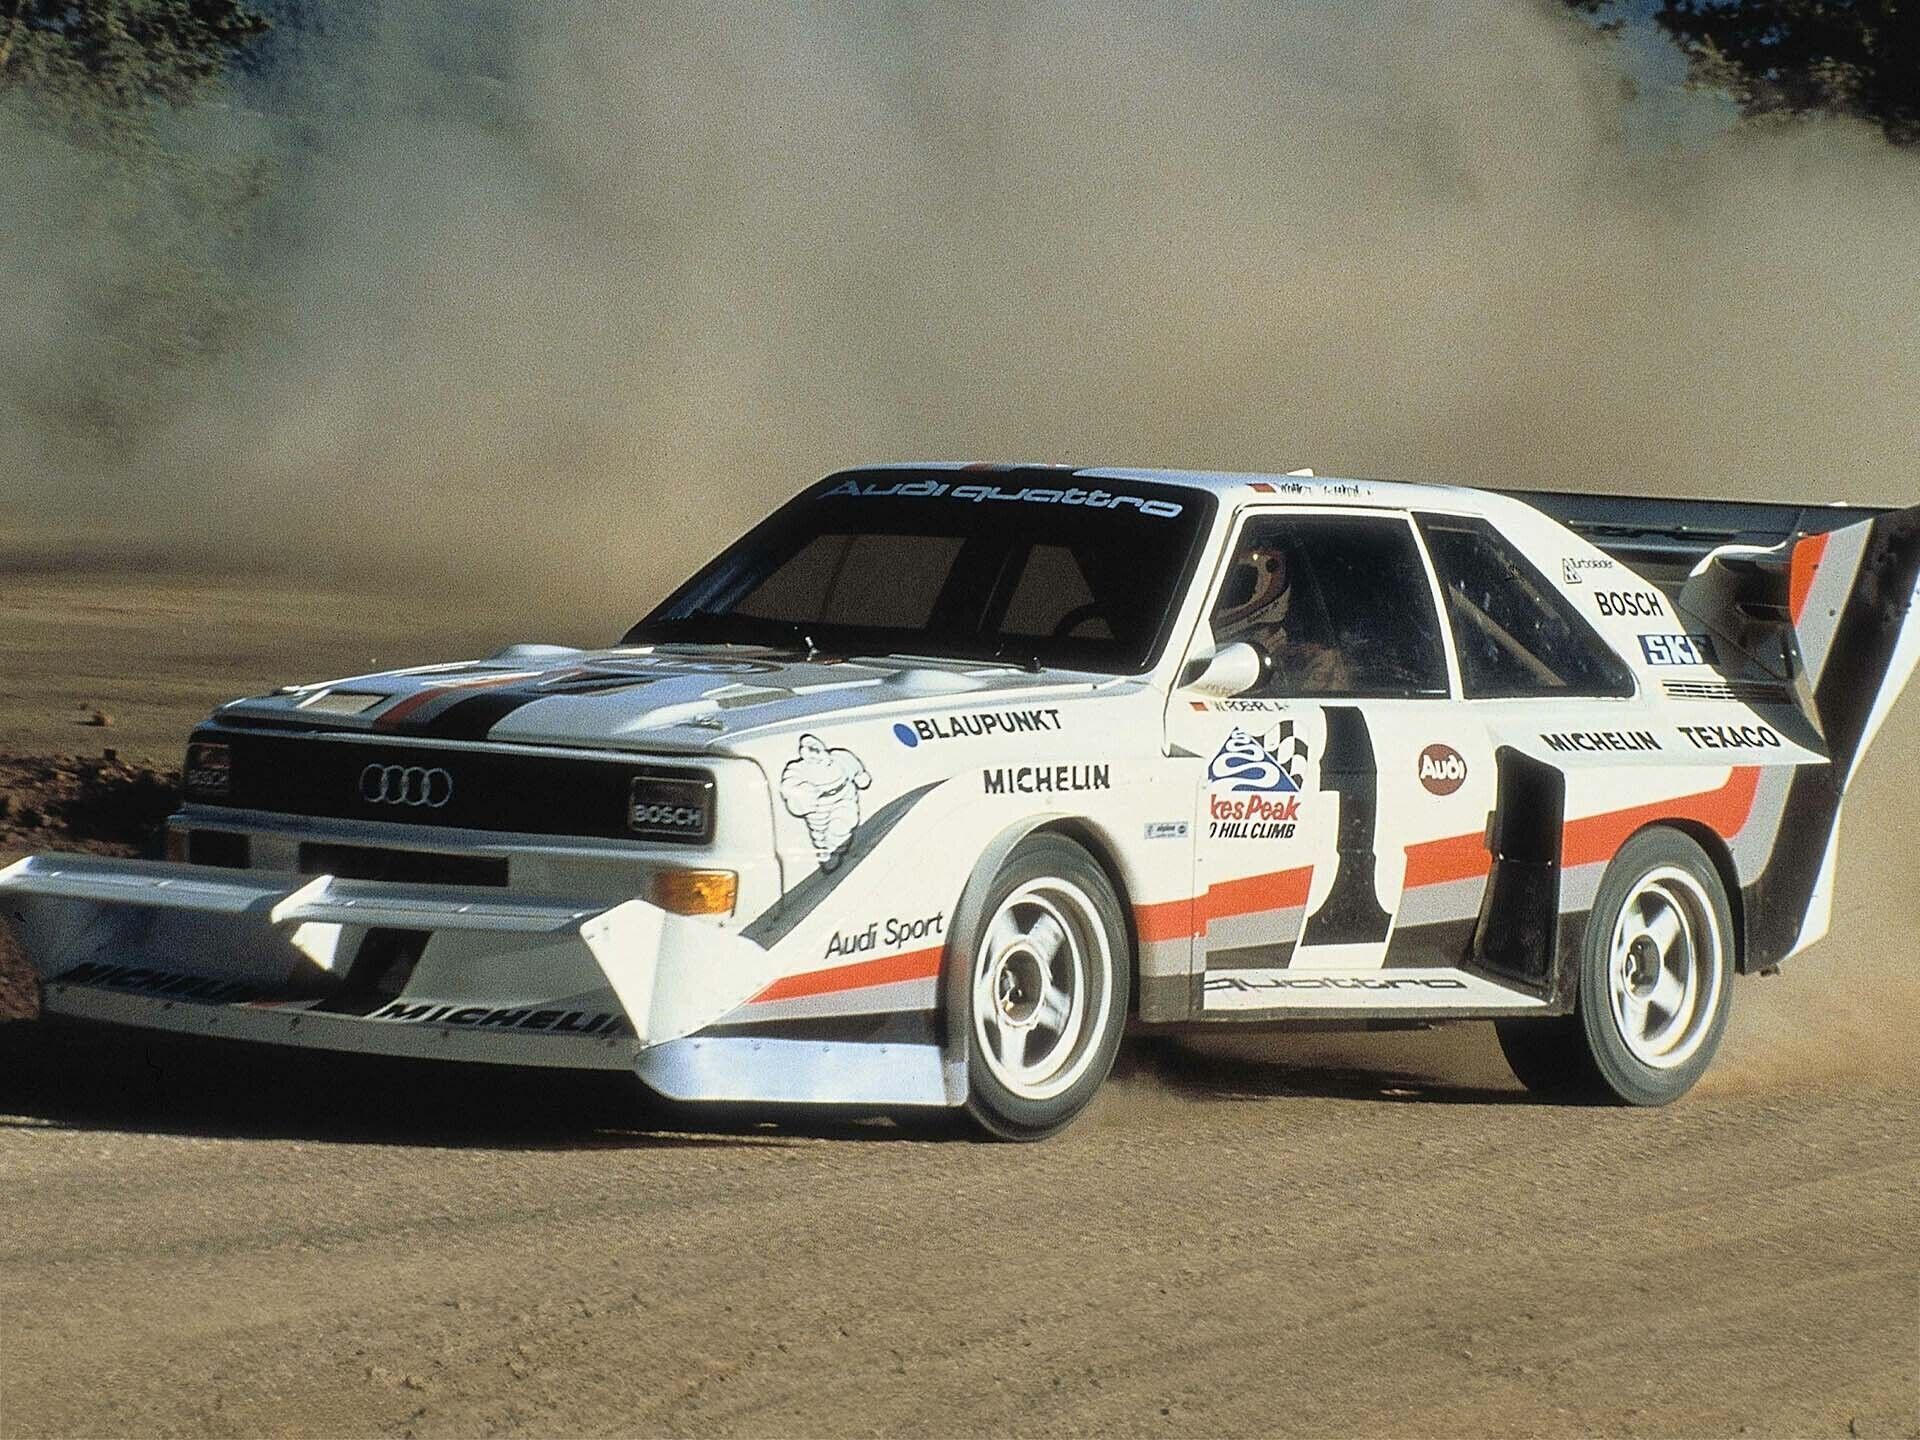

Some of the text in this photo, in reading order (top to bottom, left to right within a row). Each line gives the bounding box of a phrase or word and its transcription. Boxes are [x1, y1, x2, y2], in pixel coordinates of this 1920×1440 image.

[816, 479, 1184, 518] Audi quattro
[1594, 591, 1665, 617] BOSCH
[913, 709, 1064, 741] BLAUPUNKT
[1540, 726, 1782, 751] MICHELIN TEXACO
[982, 763, 1111, 795] MICHELIN
[1419, 753, 1466, 780] Audi
[633, 803, 701, 827] BOSCH
[1243, 794, 1302, 821] Peak
[1218, 822, 1248, 839] HILL
[1249, 822, 1297, 839] CLIMB
[1300, 705, 1393, 948] 1
[824, 911, 945, 960] Audi Sport
[1202, 977, 1468, 992] quattro
